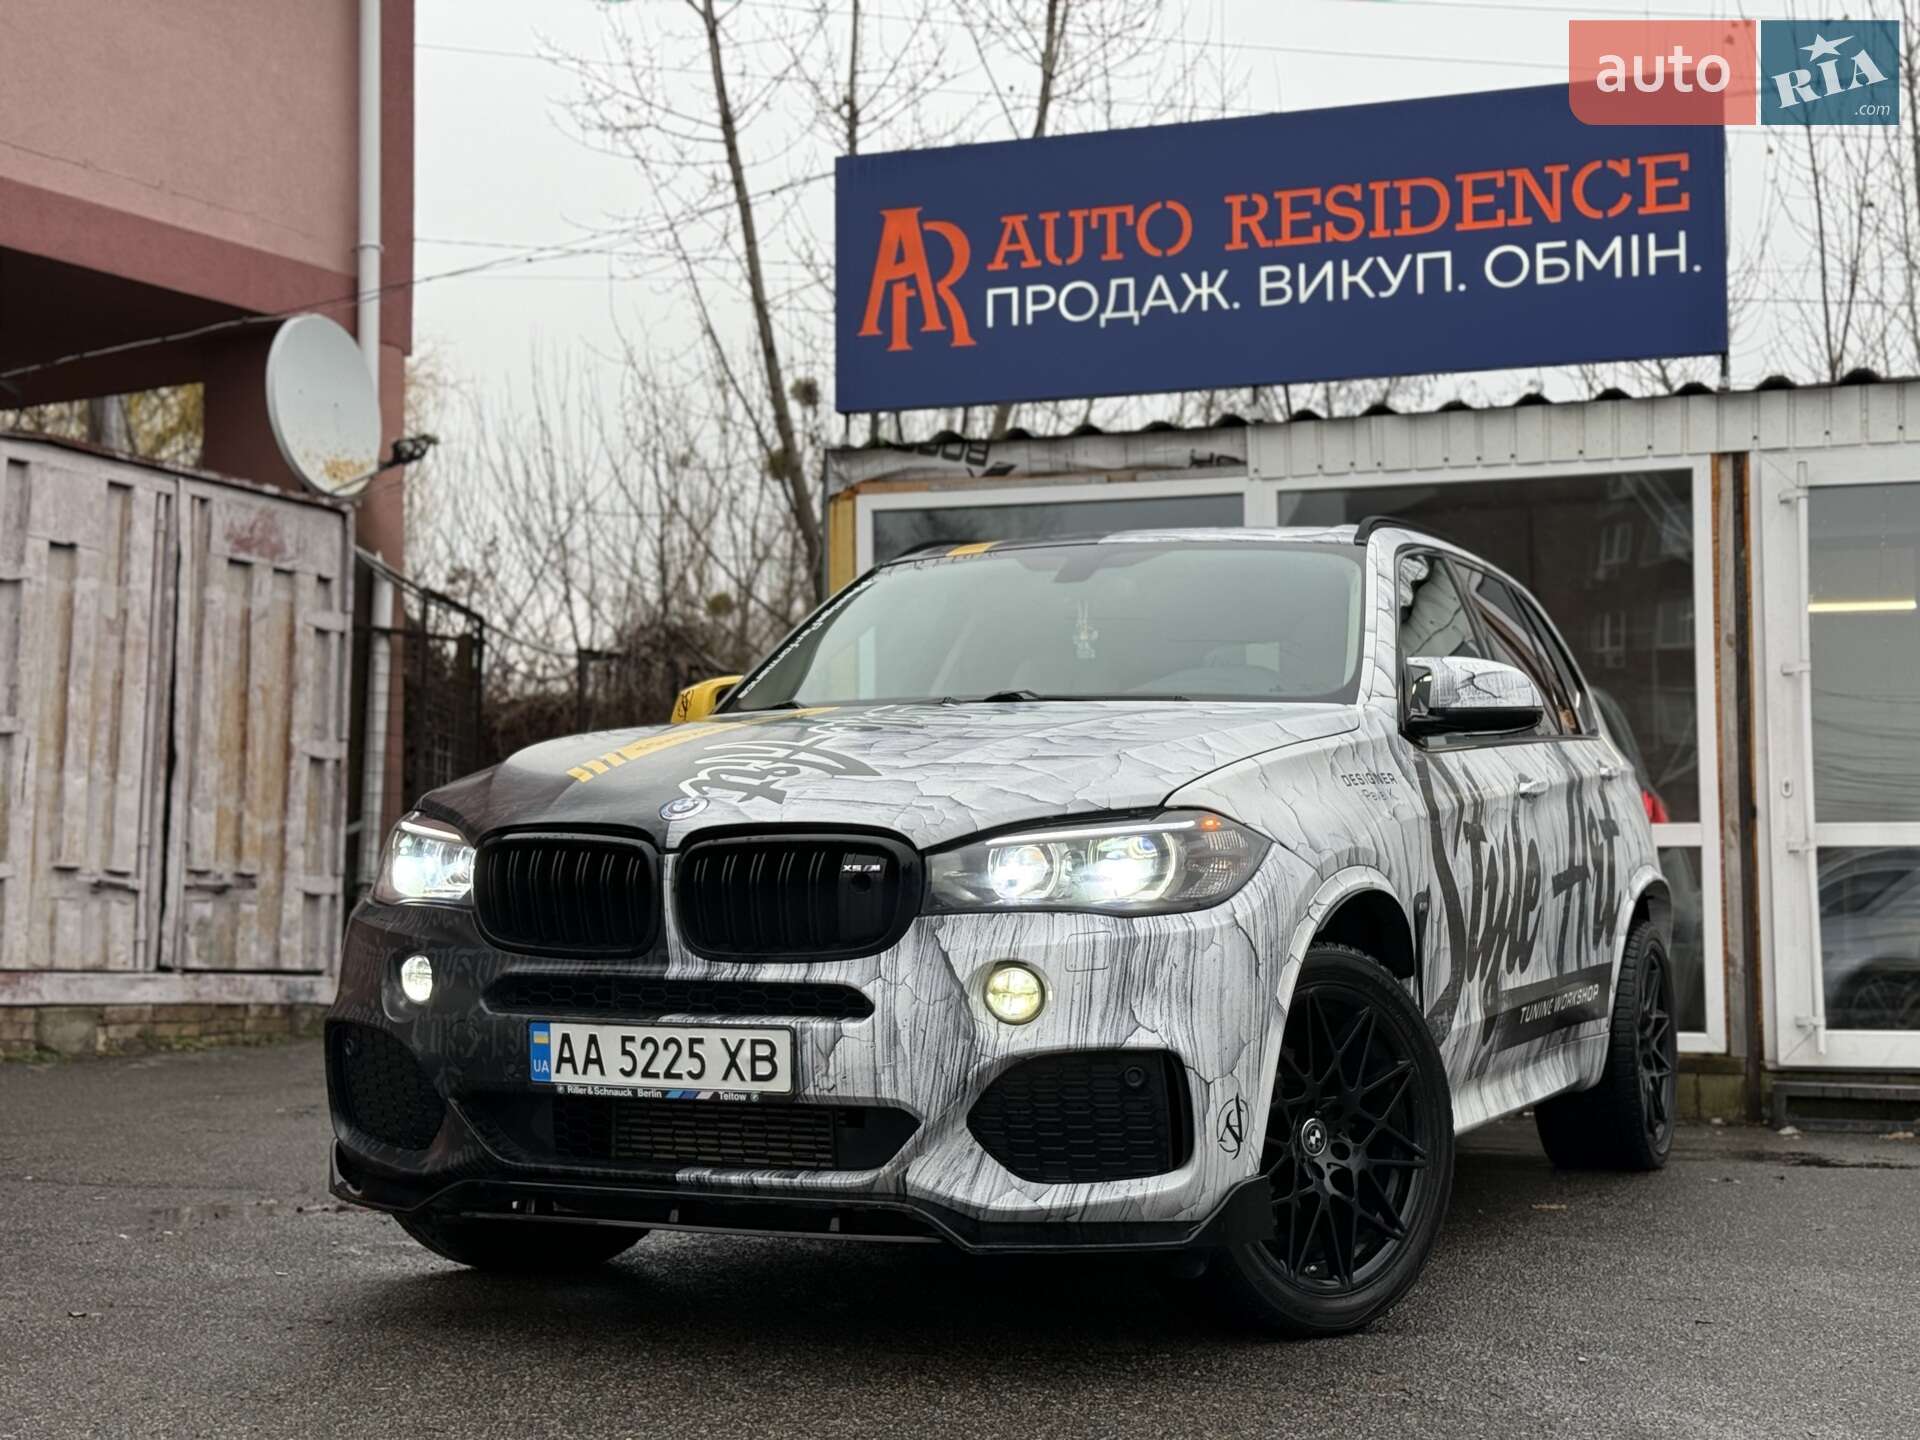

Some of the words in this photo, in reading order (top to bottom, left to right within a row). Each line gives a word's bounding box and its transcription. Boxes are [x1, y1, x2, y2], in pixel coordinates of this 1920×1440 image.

[986, 199, 1194, 272] AUTO
[1224, 153, 1691, 252] RESIDENCE
[986, 258, 1241, 329] ПРОДАЖ.
[1259, 249, 1468, 308] ВИКУП.
[1483, 229, 1702, 289] ОБМІН.
[1341, 772, 1398, 787] DESIGNER
[1553, 983, 1600, 1013] WORKSHOP
[533, 1060, 549, 1073] UA
[555, 1032, 606, 1076] AA
[618, 1035, 706, 1080] 5225
[720, 1037, 778, 1082] XB
[637, 1088, 663, 1099] Berlin
